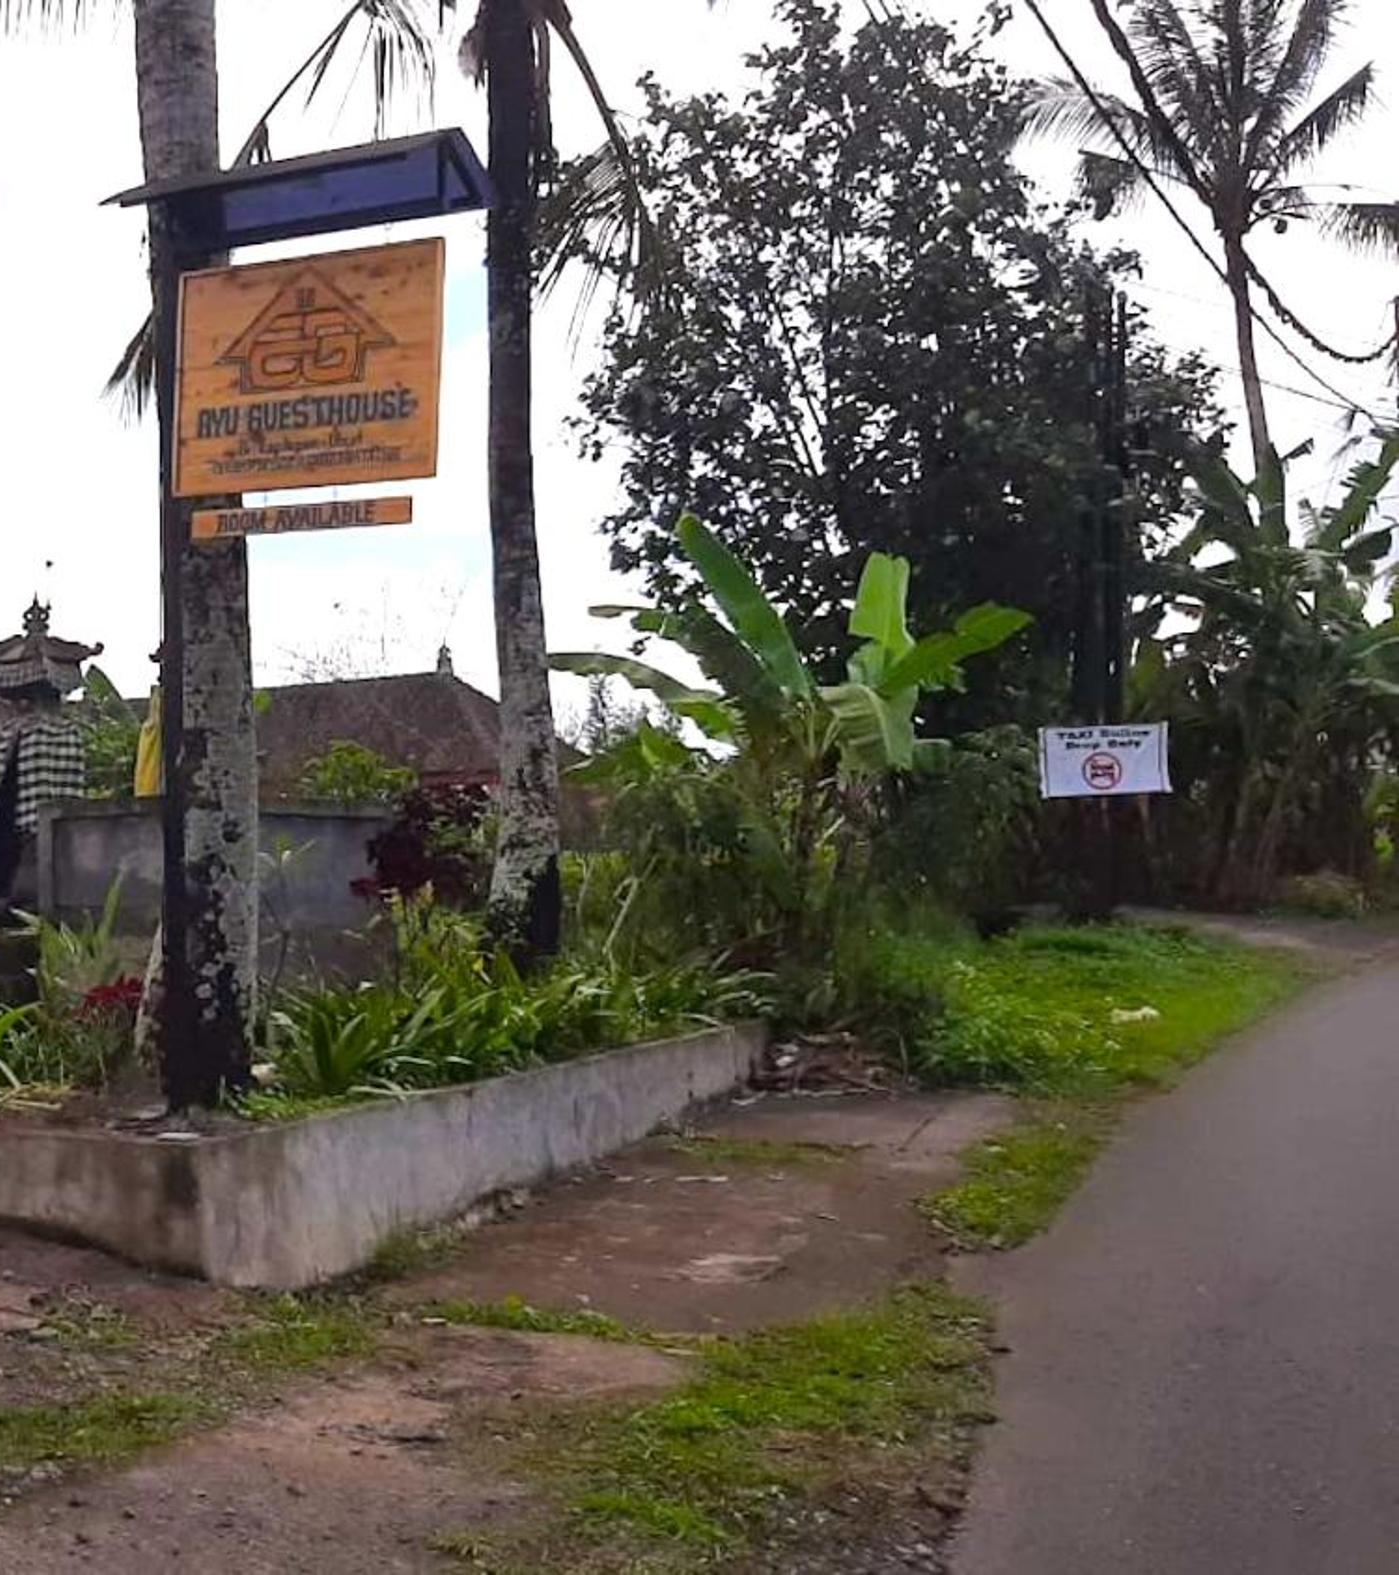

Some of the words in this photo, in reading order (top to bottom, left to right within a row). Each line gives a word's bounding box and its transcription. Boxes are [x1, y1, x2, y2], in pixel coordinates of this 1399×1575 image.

[197, 406, 240, 439] AYU
[248, 388, 414, 432] GUESTHOUSE
[216, 510, 267, 534] ROOM
[274, 500, 376, 530] AVAILABLE
[1056, 731, 1093, 740] TAXI
